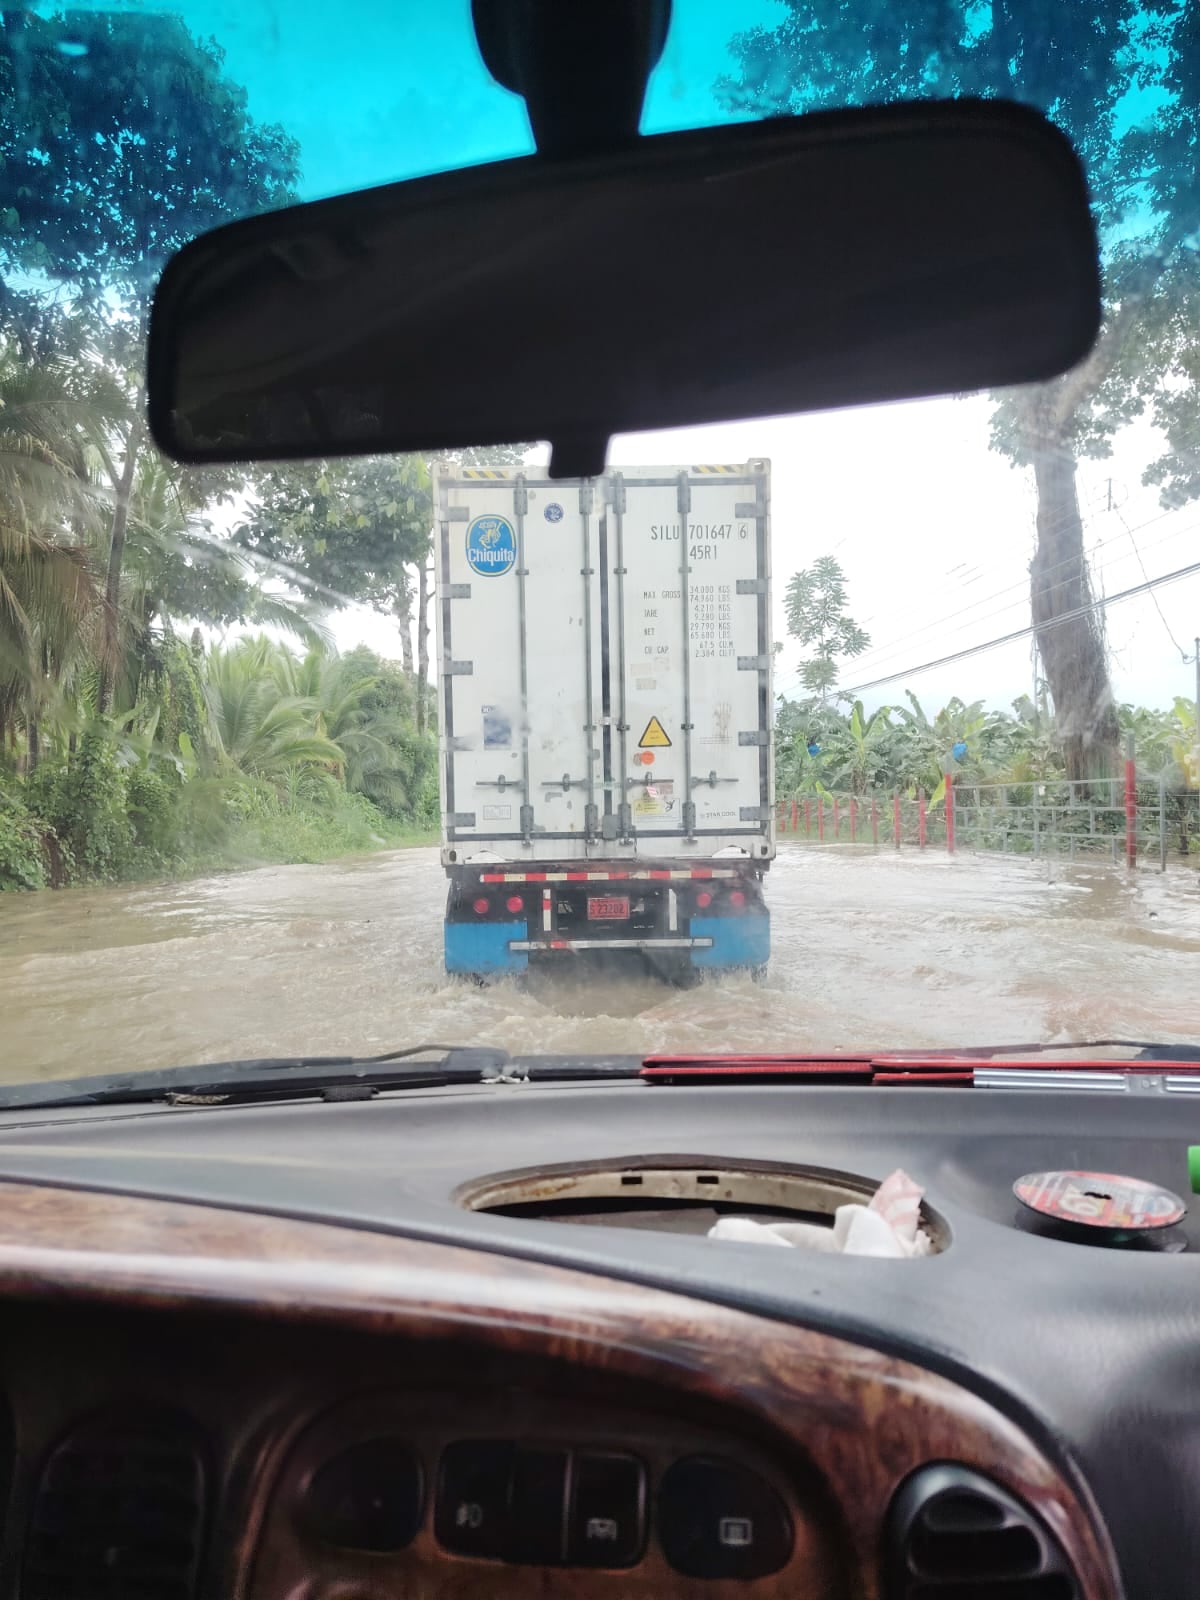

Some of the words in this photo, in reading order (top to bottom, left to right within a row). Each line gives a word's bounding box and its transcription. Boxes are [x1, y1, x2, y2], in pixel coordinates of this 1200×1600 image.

[650, 525, 680, 540] SILU
[689, 524, 732, 539] 701647
[739, 524, 747, 539] 6
[468, 547, 515, 567] Chiquita
[689, 545, 717, 560] 45R1
[643, 591, 656, 600] MAX
[661, 590, 681, 599] GROSS
[643, 628, 655, 636] NET
[656, 645, 669, 654] CAP
